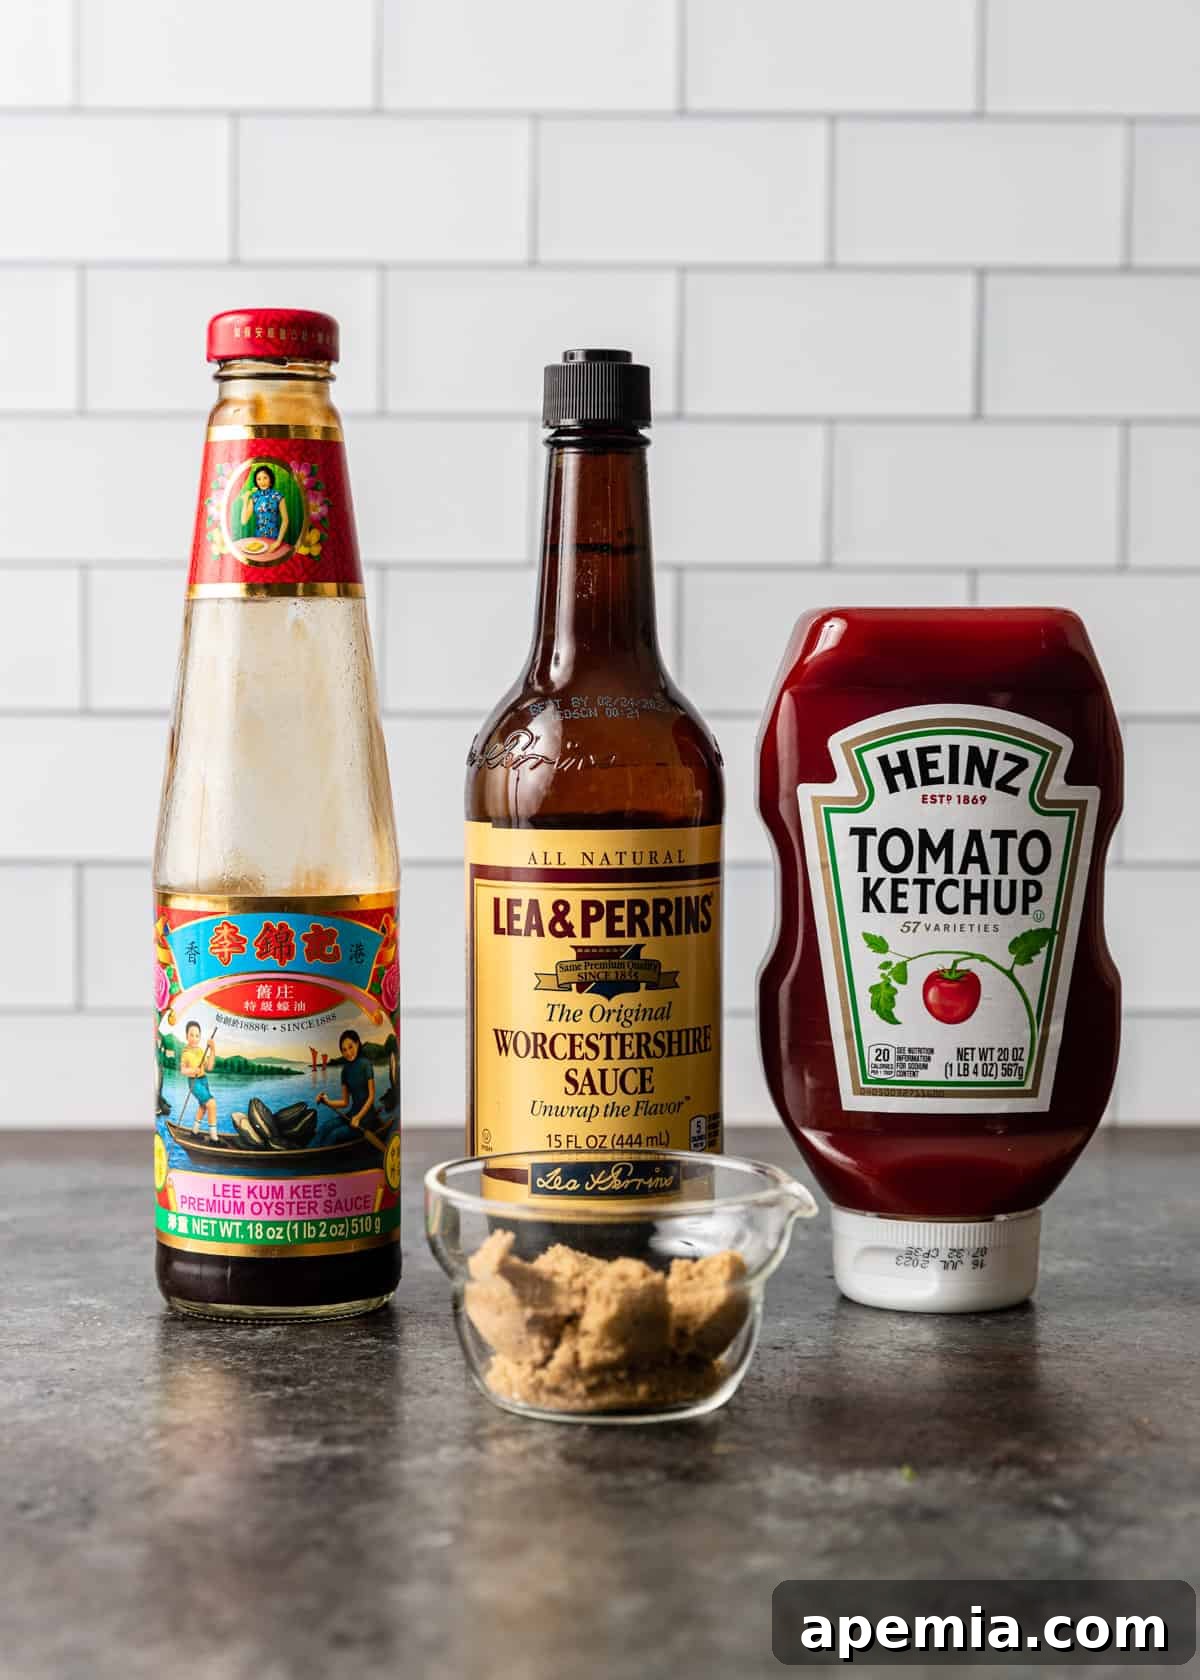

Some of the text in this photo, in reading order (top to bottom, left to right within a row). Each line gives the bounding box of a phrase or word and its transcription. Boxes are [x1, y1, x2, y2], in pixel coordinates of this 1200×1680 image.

[877, 744, 1030, 797] HEINZ
[956, 794, 987, 805] 1869
[528, 849, 686, 866] ALL NATURAL
[849, 827, 1052, 875] TOMATO
[861, 877, 1043, 915] KETCHUP
[900, 921, 1000, 934] 57 VARIETIES
[184, 920, 366, 967] 香 李錦記 港
[584, 960, 624, 970] Premium
[577, 971, 609, 981] SINCE
[546, 1001, 673, 1028] The Original
[493, 1024, 712, 1061] WORCESTERSHIRE
[908, 1047, 934, 1055] NUTRITION
[875, 1048, 890, 1062] 20
[896, 1055, 932, 1063] INFORMATION
[956, 1047, 1025, 1062] NET WT 20 OZ
[944, 1063, 1025, 1080] (1 LB 4 OZ) 567g
[564, 1066, 655, 1096] SAUCE
[529, 1099, 600, 1122] Unwrap
[602, 1101, 631, 1118] the
[546, 1131, 670, 1150] 15 FL OZ (444 mL)
[536, 1167, 580, 1191] Lea
[212, 1183, 337, 1200] LEE KUM KEE'S
[180, 1194, 371, 1217] PREMIUM OYSTER SAUCE
[192, 1218, 217, 1237] NET
[219, 1220, 245, 1239] WT.
[247, 1222, 264, 1240] 18
[266, 1227, 284, 1240] oz
[286, 1221, 299, 1243] (1
[303, 1222, 316, 1239] lb
[319, 1221, 327, 1238] 2
[351, 1215, 372, 1234] 510
[374, 1216, 382, 1234] g
[895, 1256, 987, 1271] 16 JUL 2023
